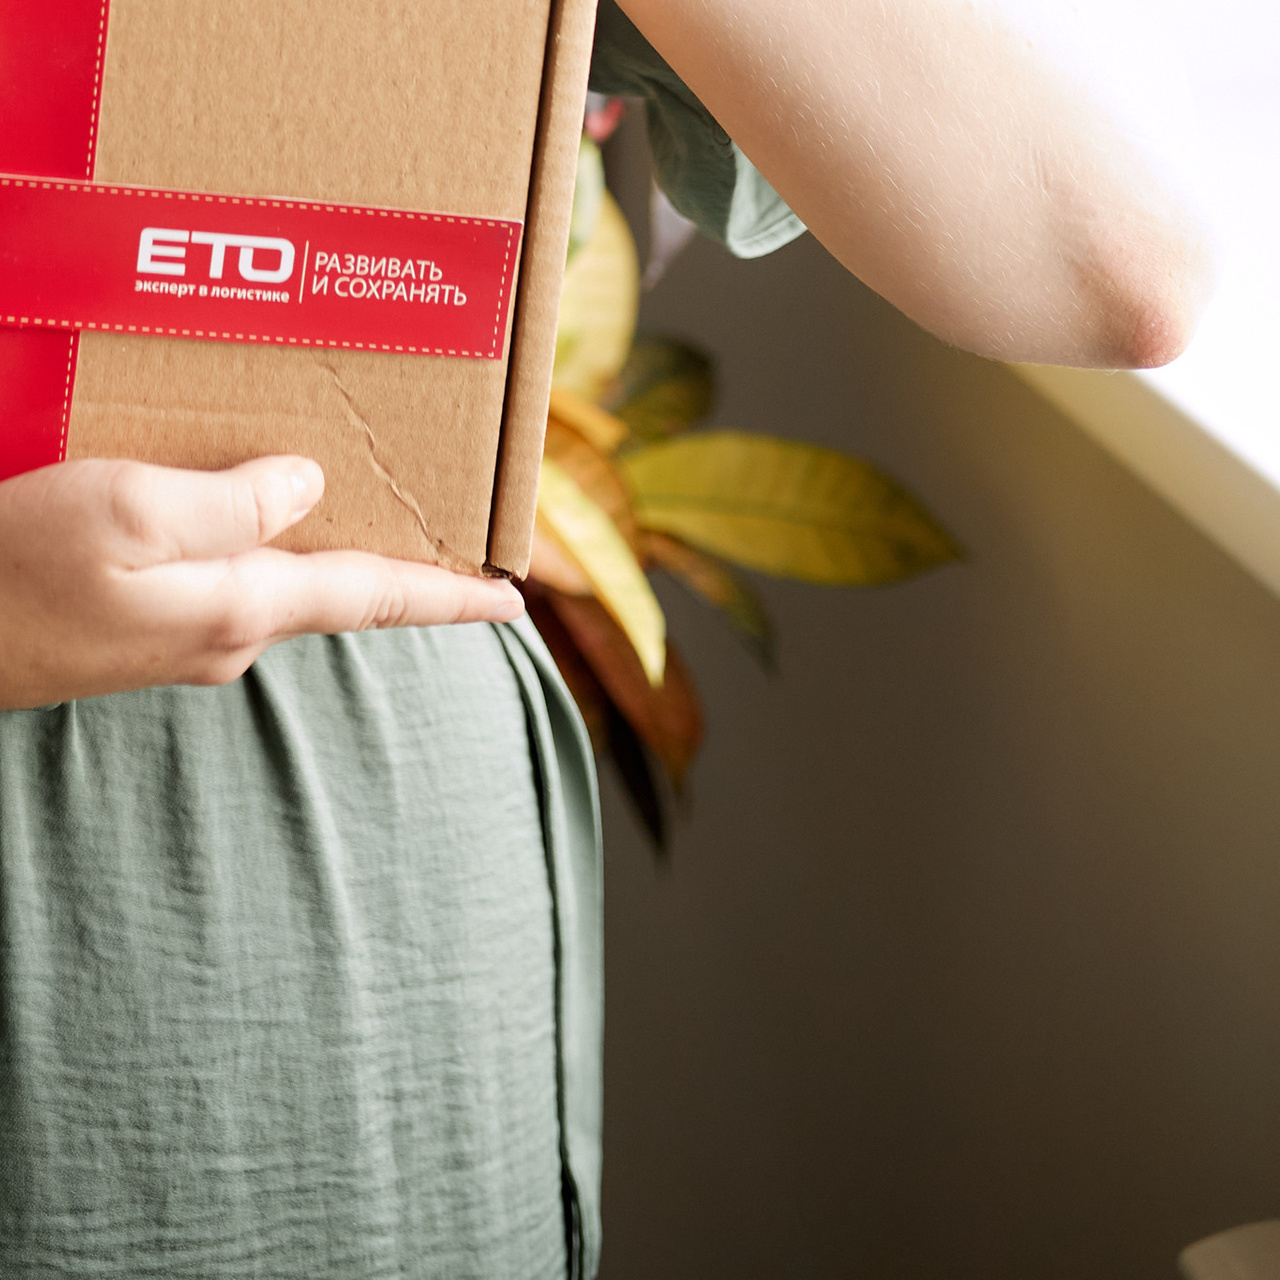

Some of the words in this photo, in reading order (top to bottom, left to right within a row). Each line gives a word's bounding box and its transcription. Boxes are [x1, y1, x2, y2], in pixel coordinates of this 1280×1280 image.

[314, 251, 443, 282] РАЗВИВАТЬ
[134, 279, 196, 298] эксперт
[198, 284, 208, 297] в
[210, 286, 290, 304] логистике
[311, 274, 329, 296] И
[334, 276, 467, 306] СОХРАНЯТЬ
